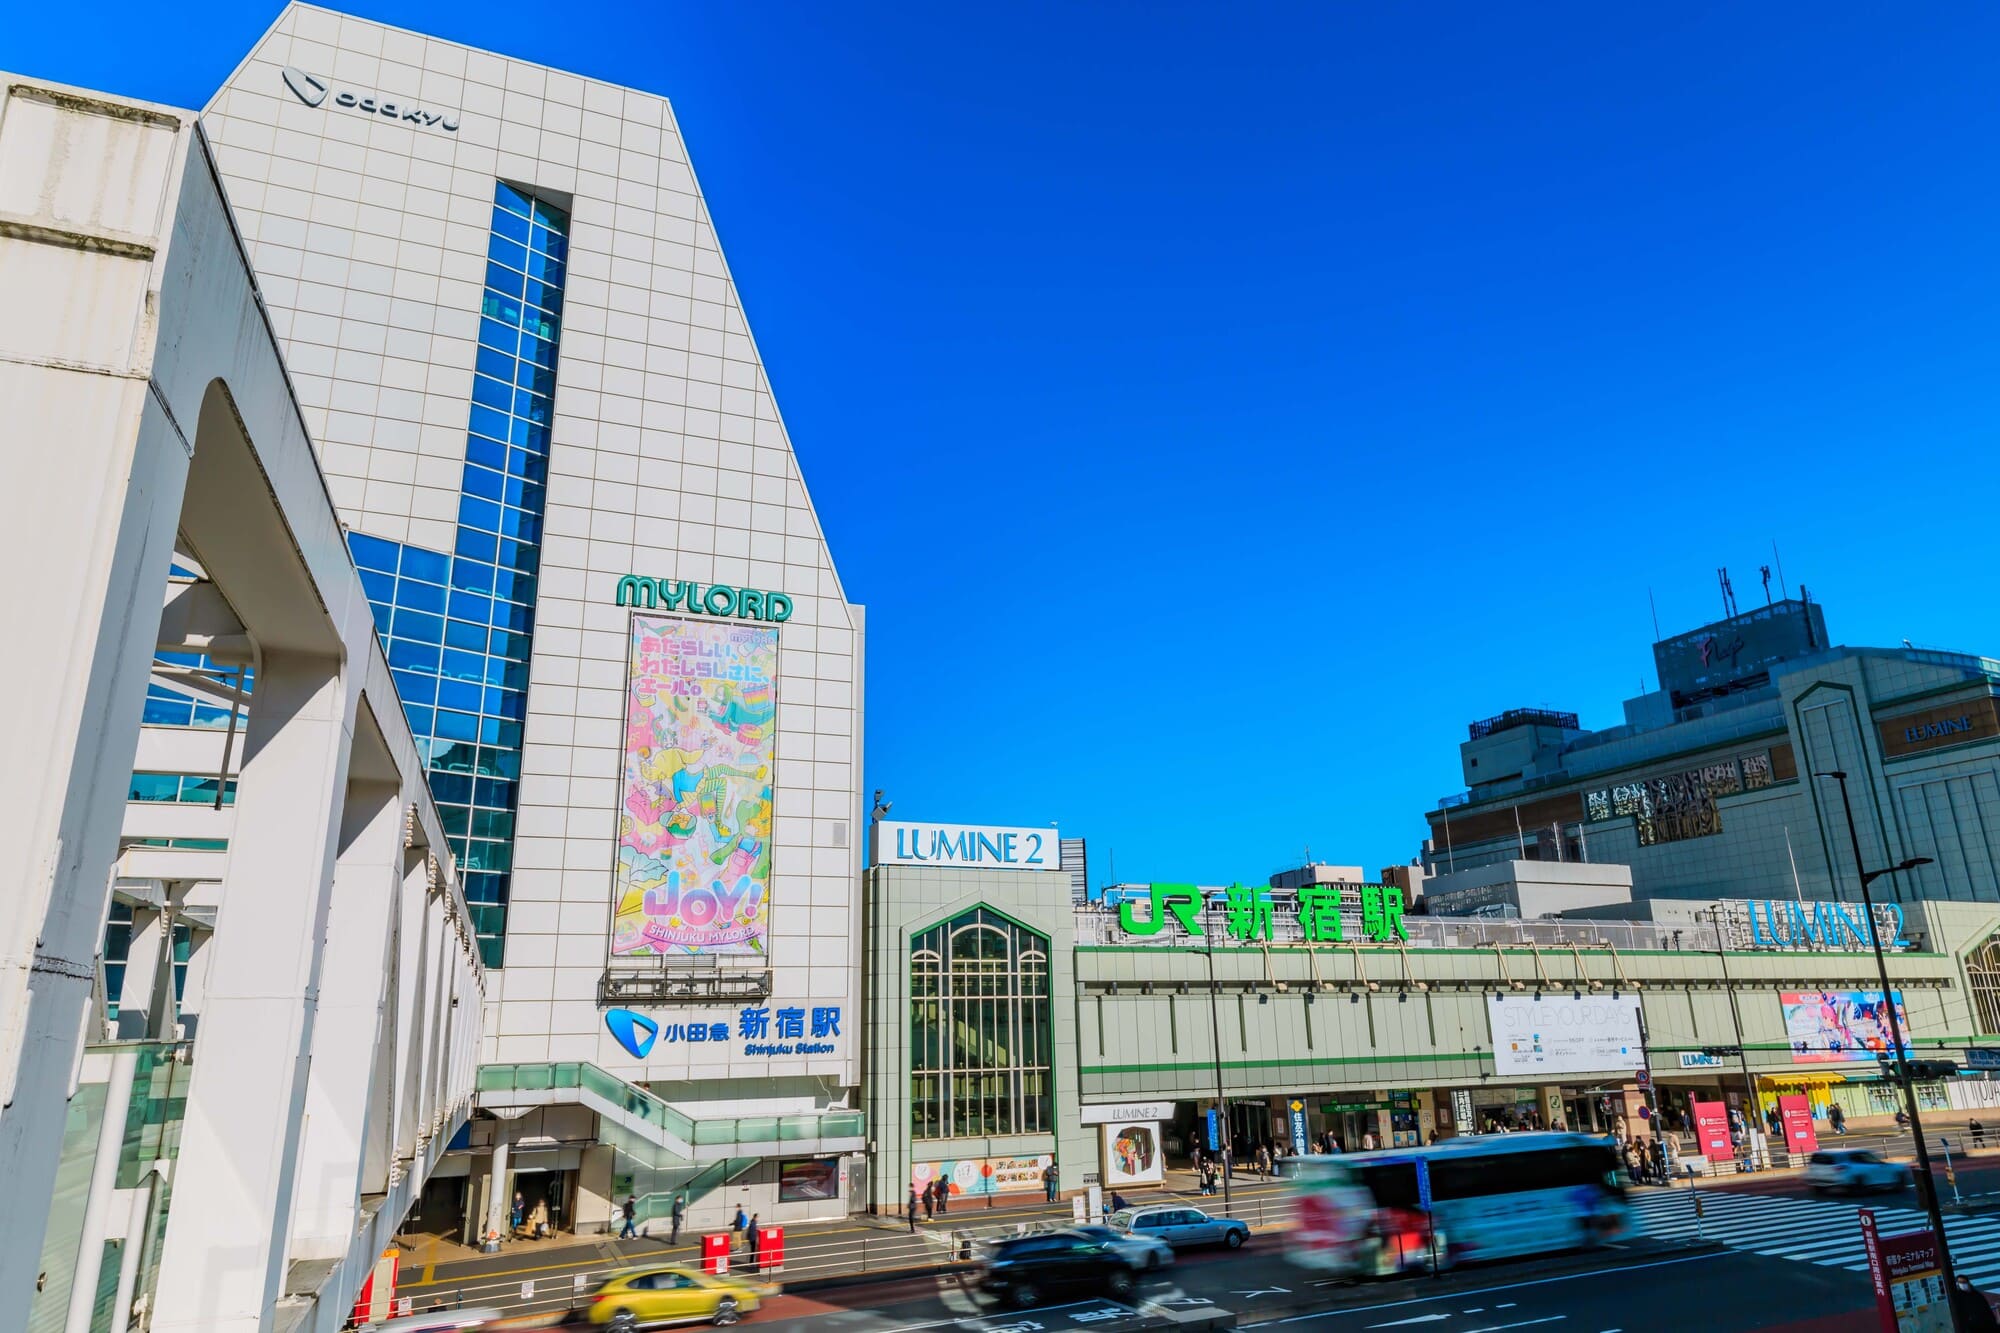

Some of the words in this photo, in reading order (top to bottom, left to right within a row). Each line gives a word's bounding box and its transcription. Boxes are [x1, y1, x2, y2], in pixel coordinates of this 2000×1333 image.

[616, 574, 794, 622] MYLORD
[640, 636, 738, 661] あたらしい、
[639, 655, 770, 683] わたしらしさに、
[638, 678, 702, 696] エール。
[1904, 716, 1974, 743] LUMINE
[896, 828, 1018, 863] LUMINE
[1025, 833, 1043, 863] 2
[643, 870, 764, 927] JOY!
[649, 924, 705, 943] SHINJUKU
[708, 926, 755, 942] MYLORD
[1886, 903, 1910, 946] 2
[664, 1023, 730, 1042] 小田急
[738, 1006, 841, 1040] 新宿駅
[744, 1043, 793, 1058] Shinjuku
[795, 1042, 835, 1055] Station
[1112, 1107, 1150, 1120] LUMINE
[1151, 1106, 1158, 1118] 2
